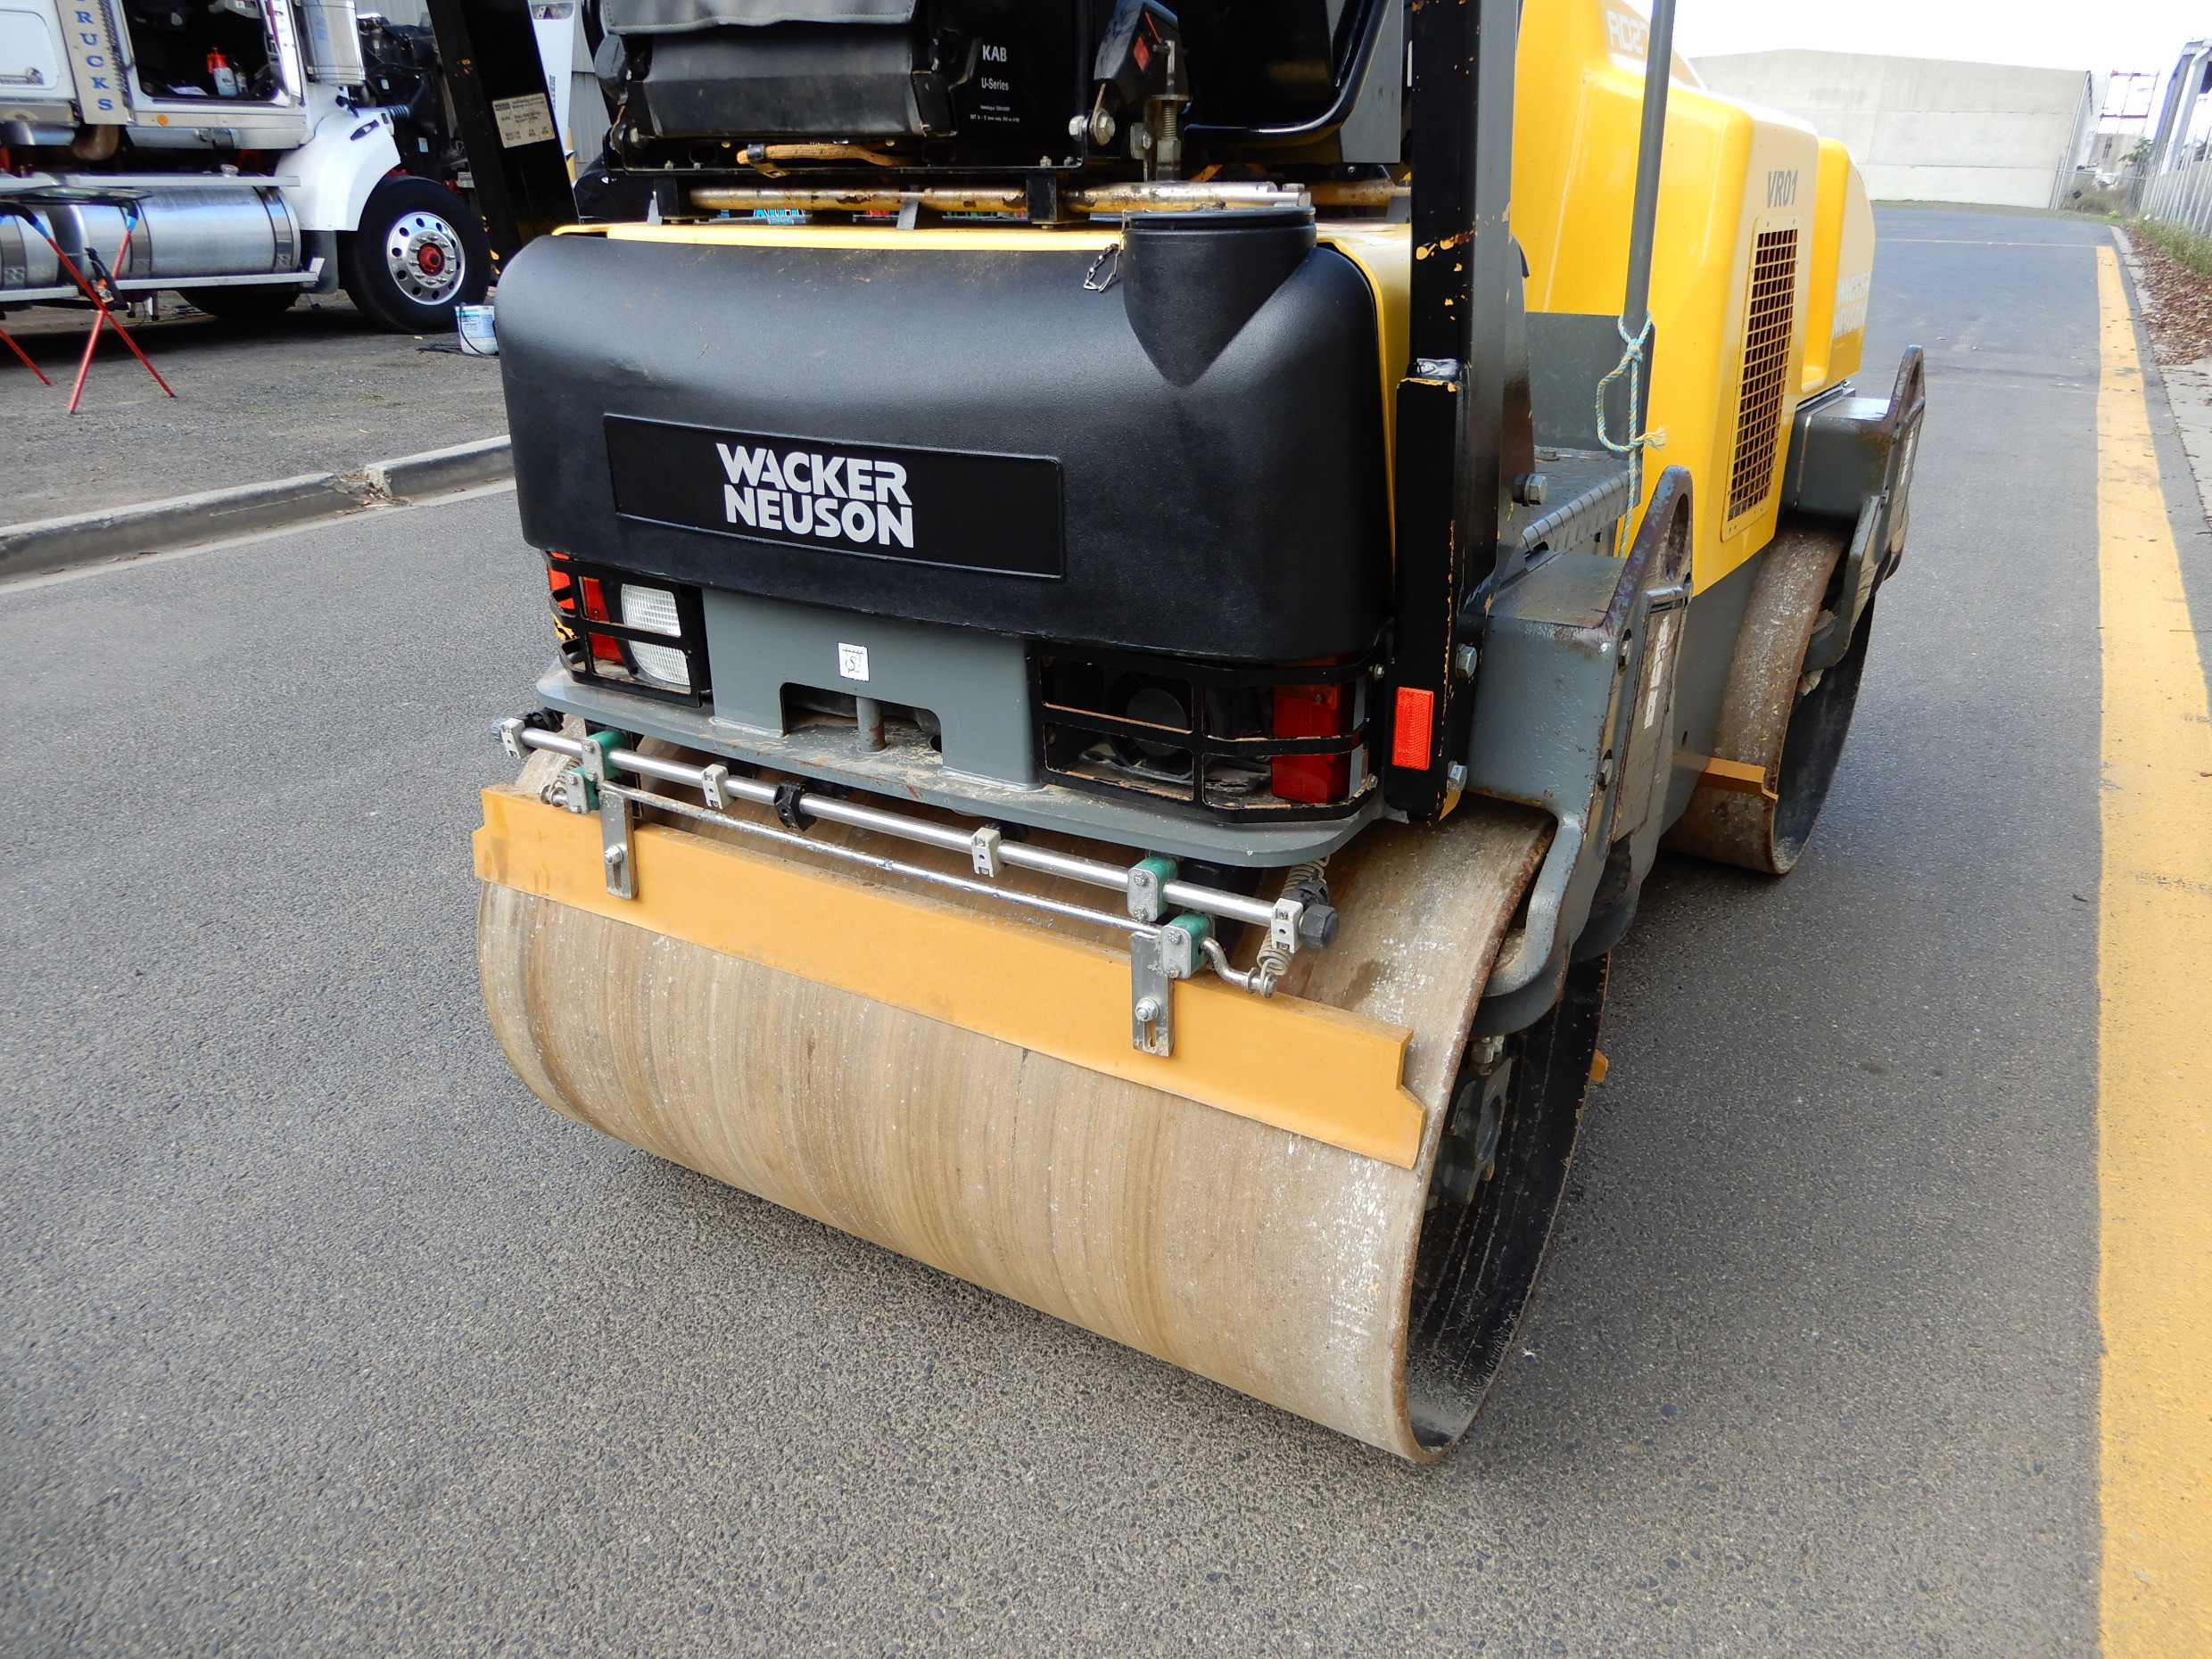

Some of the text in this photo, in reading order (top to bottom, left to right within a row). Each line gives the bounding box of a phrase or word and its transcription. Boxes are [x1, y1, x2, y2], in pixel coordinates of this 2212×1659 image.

[75, 0, 113, 111] RUCKS
[982, 45, 1008, 62] KAB
[981, 77, 1010, 91] U-Series
[1767, 169, 1799, 209] VR01
[715, 442, 913, 506] WACKER
[724, 483, 915, 549] NEUSON
